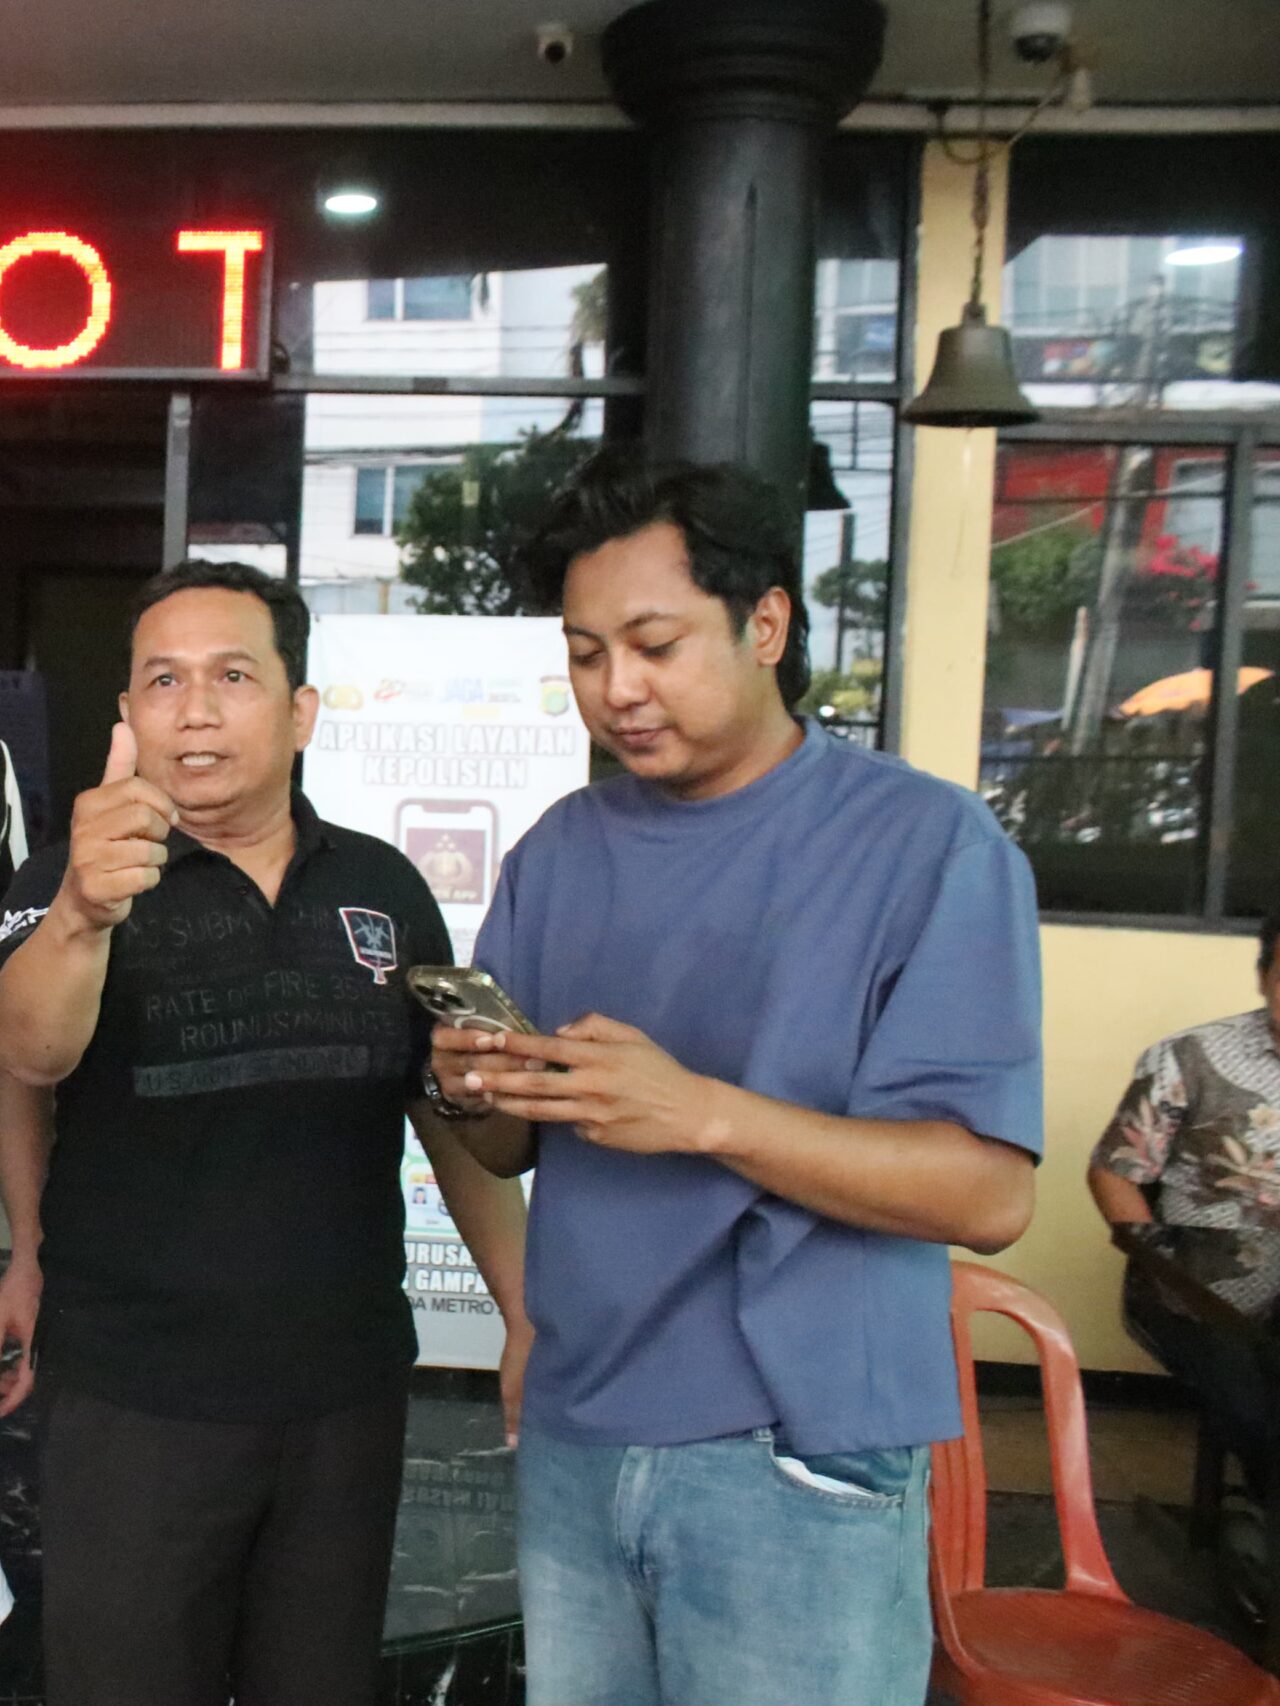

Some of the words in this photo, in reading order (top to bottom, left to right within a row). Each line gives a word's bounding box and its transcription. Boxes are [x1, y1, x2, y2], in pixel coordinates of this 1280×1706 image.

[177, 230, 264, 371] T
[319, 720, 447, 753] APLIKASI
[450, 724, 576, 756] LAYANAN
[363, 754, 528, 789] KEPOLISIAN
[404, 1242, 477, 1267] URUSA
[431, 1298, 495, 1315] METRO
